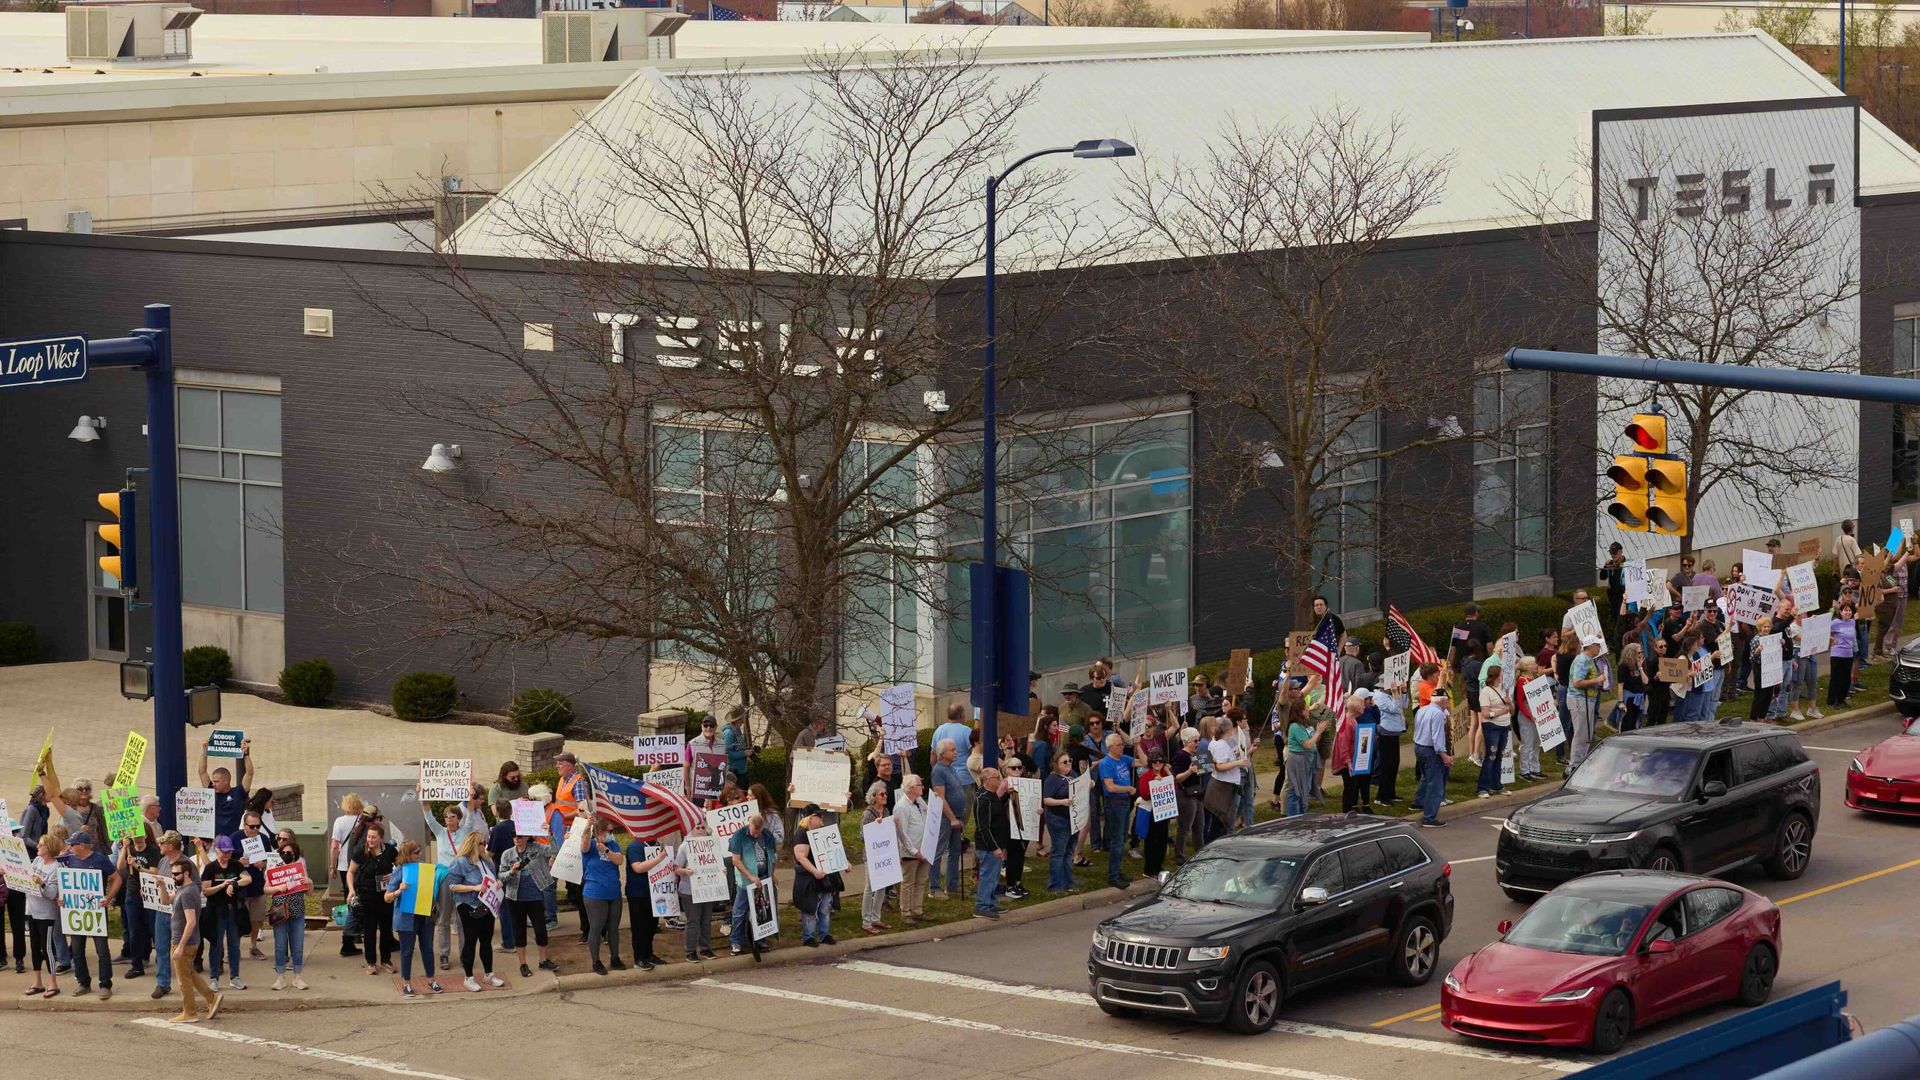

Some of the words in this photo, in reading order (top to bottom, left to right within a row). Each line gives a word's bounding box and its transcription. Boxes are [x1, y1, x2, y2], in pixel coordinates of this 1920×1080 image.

[1628, 163, 1835, 220] TESLA
[594, 312, 884, 382] TESLA
[6, 349, 43, 379] Loop
[46, 344, 80, 371] West
[1761, 595, 1776, 604] BUY
[1859, 584, 1875, 607] NO
[1153, 672, 1174, 688] WAKE
[1175, 672, 1186, 686] UP
[1156, 690, 1178, 700] AMERICA
[1526, 687, 1542, 700] Things
[1536, 701, 1550, 715] NOT
[1541, 728, 1555, 742] Stand
[639, 737, 656, 747] NOT
[658, 736, 677, 746] PAID
[423, 760, 460, 769] MEDICAID
[638, 752, 679, 765] PISSED
[425, 770, 467, 778] LIFESAVING
[645, 769, 681, 781] EMBRACE
[443, 779, 470, 787] SICKEST
[1152, 784, 1173, 794] FIGHT
[202, 790, 213, 799] try
[423, 787, 445, 799] MOST
[451, 787, 470, 799] NEED
[1153, 790, 1174, 801] TRUTH
[1153, 797, 1175, 808] DECAY
[717, 804, 749, 823] STOP
[687, 839, 714, 854] TRUMP
[812, 832, 839, 852] Fire
[872, 840, 891, 850] Dump
[698, 853, 717, 867] MAGA
[874, 858, 892, 870] DOGE
[272, 870, 285, 878] STOP
[286, 867, 297, 875] THE
[60, 871, 100, 892] ELON
[68, 910, 103, 933] GO!
